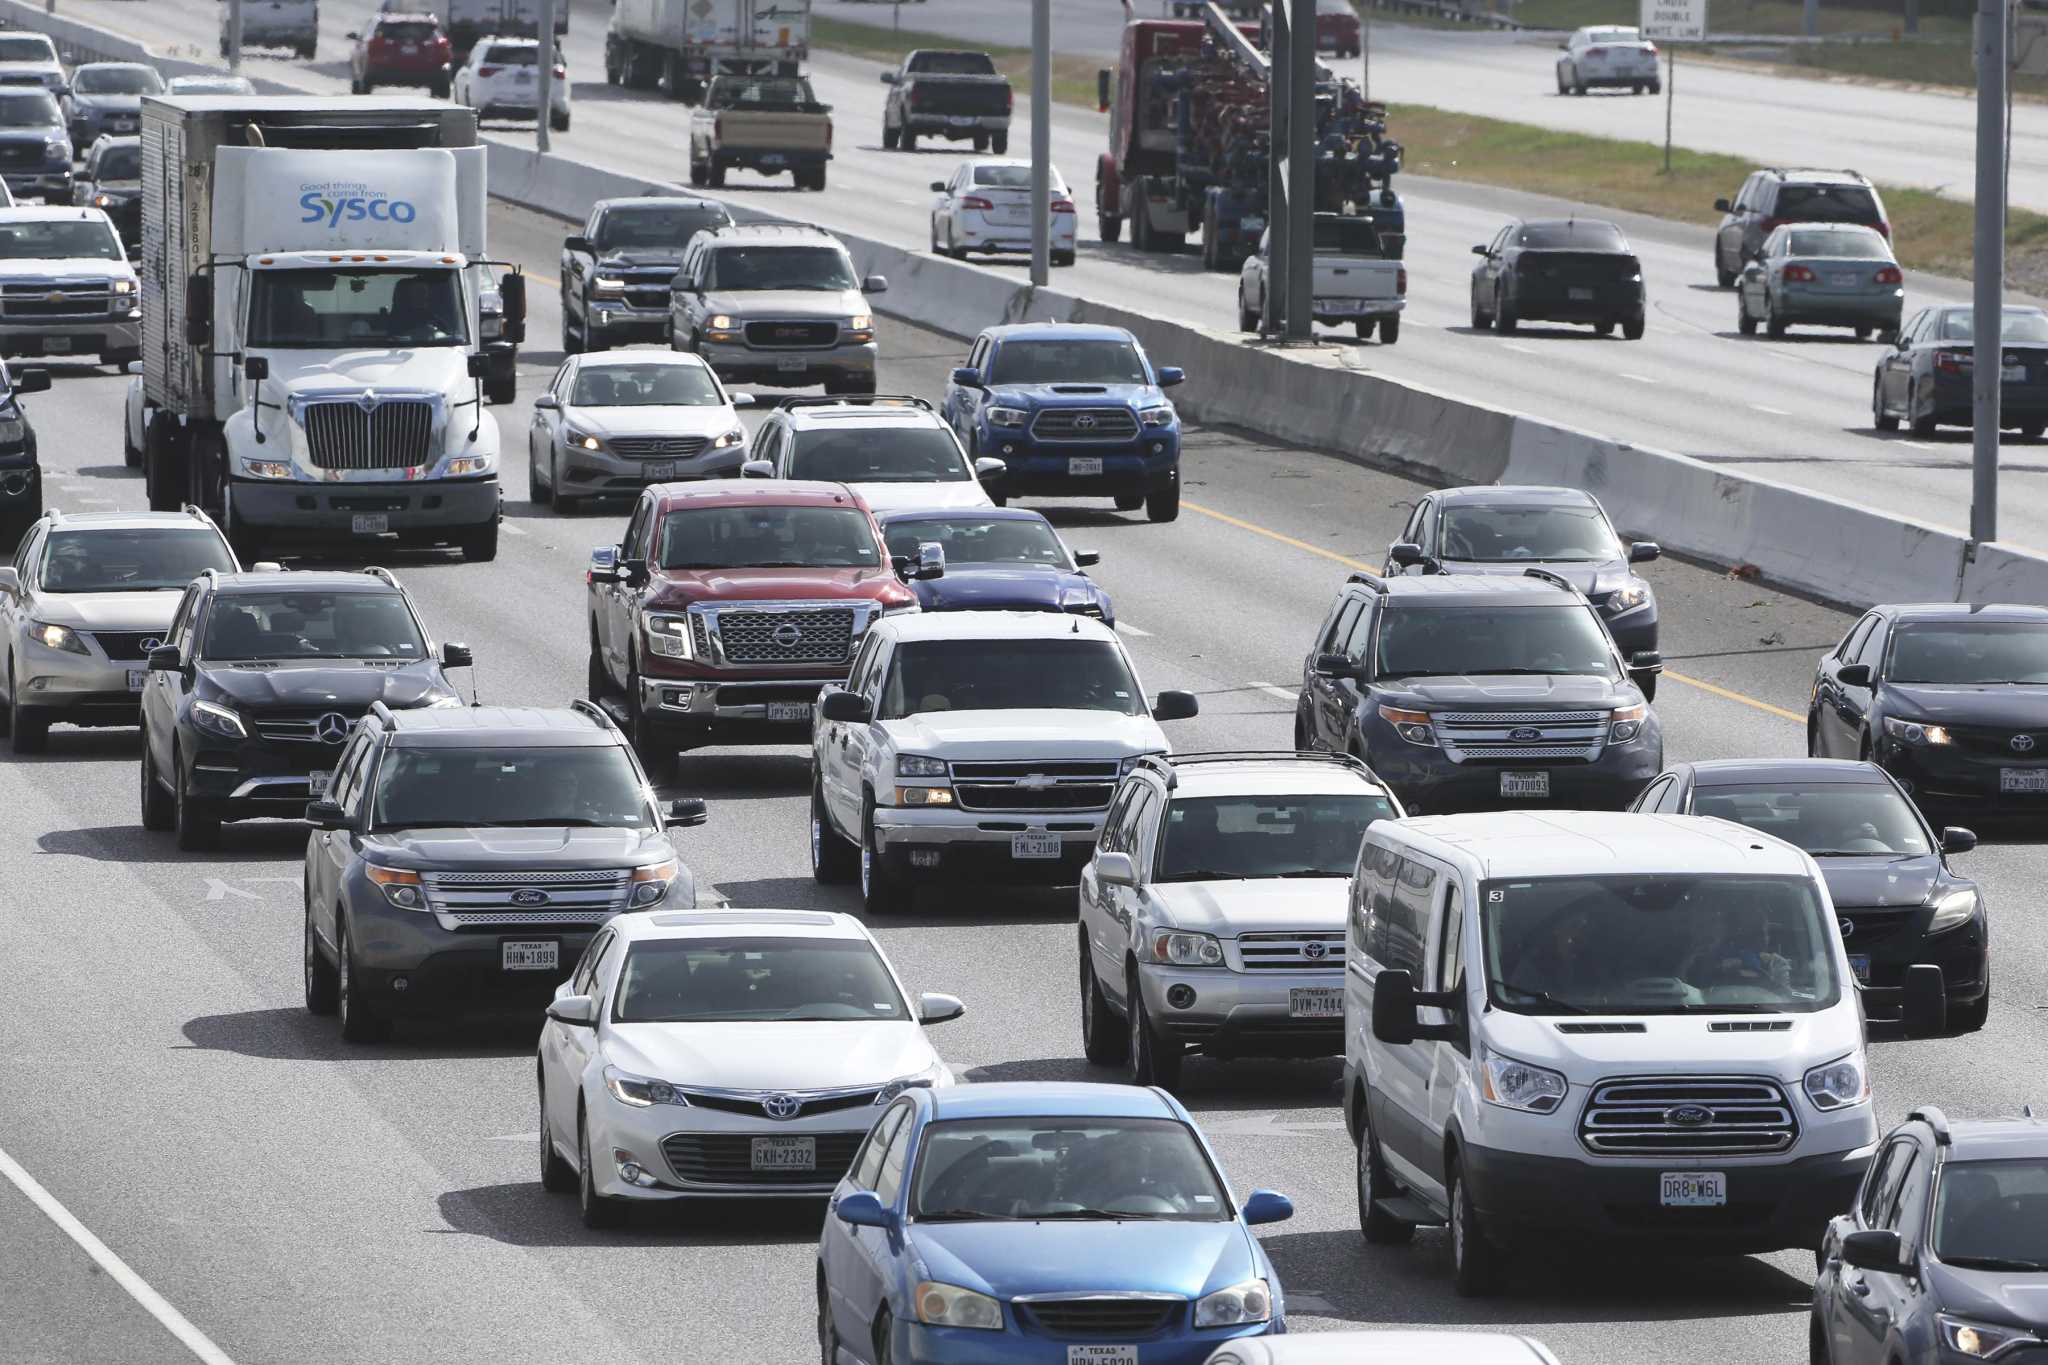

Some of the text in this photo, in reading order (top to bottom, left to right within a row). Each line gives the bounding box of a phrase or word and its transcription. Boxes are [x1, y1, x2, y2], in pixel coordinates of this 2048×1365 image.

[299, 182, 368, 193] Good things
[328, 189, 388, 199] come from
[1490, 891, 1502, 902] 3
[770, 1139, 797, 1147] TEXAS
[1087, 1347, 1117, 1355] TEXAS
